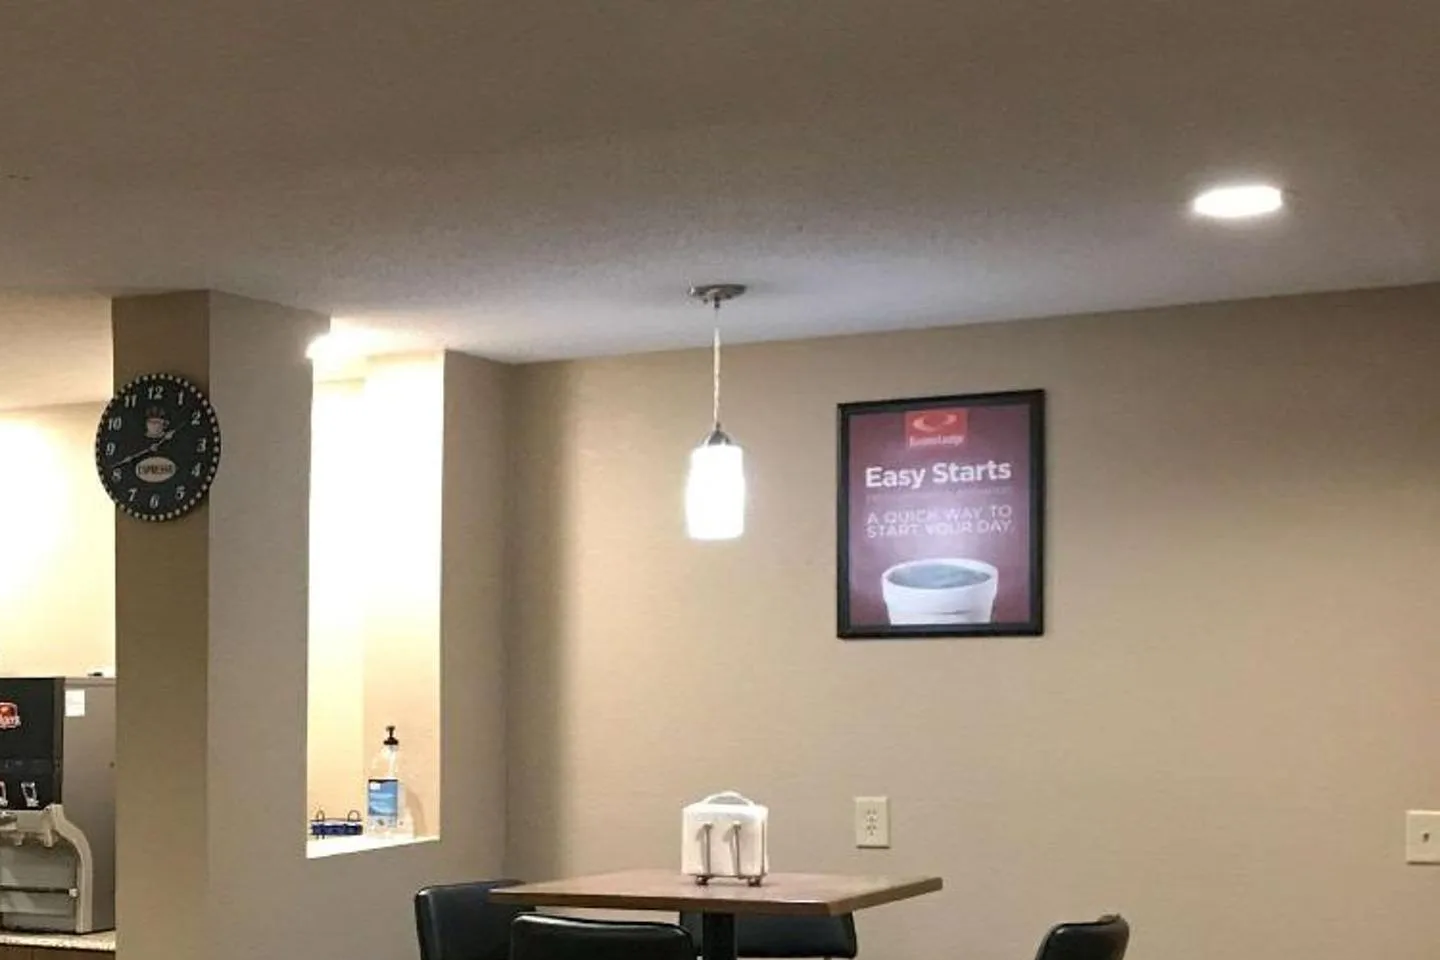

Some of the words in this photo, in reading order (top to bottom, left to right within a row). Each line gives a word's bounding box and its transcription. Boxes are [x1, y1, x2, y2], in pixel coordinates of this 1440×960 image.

[148, 386, 164, 400] 12
[177, 391, 184, 406] 1
[124, 395, 137, 408] 11
[109, 416, 122, 431] 10
[191, 410, 201, 426] 2
[105, 442, 115, 456] 9
[196, 438, 207, 453] 3
[111, 467, 122, 482] 8
[192, 462, 202, 477] 4
[865, 466, 927, 489] Easy
[932, 460, 1012, 484] Starts
[128, 487, 138, 501] 7
[175, 485, 185, 500] 5
[149, 495, 159, 509] 6
[867, 511, 879, 525] A
[883, 508, 940, 525] QUICK
[945, 506, 983, 521] WAY
[991, 504, 1013, 519] TO
[866, 523, 920, 539] START
[923, 520, 973, 536] YOUR
